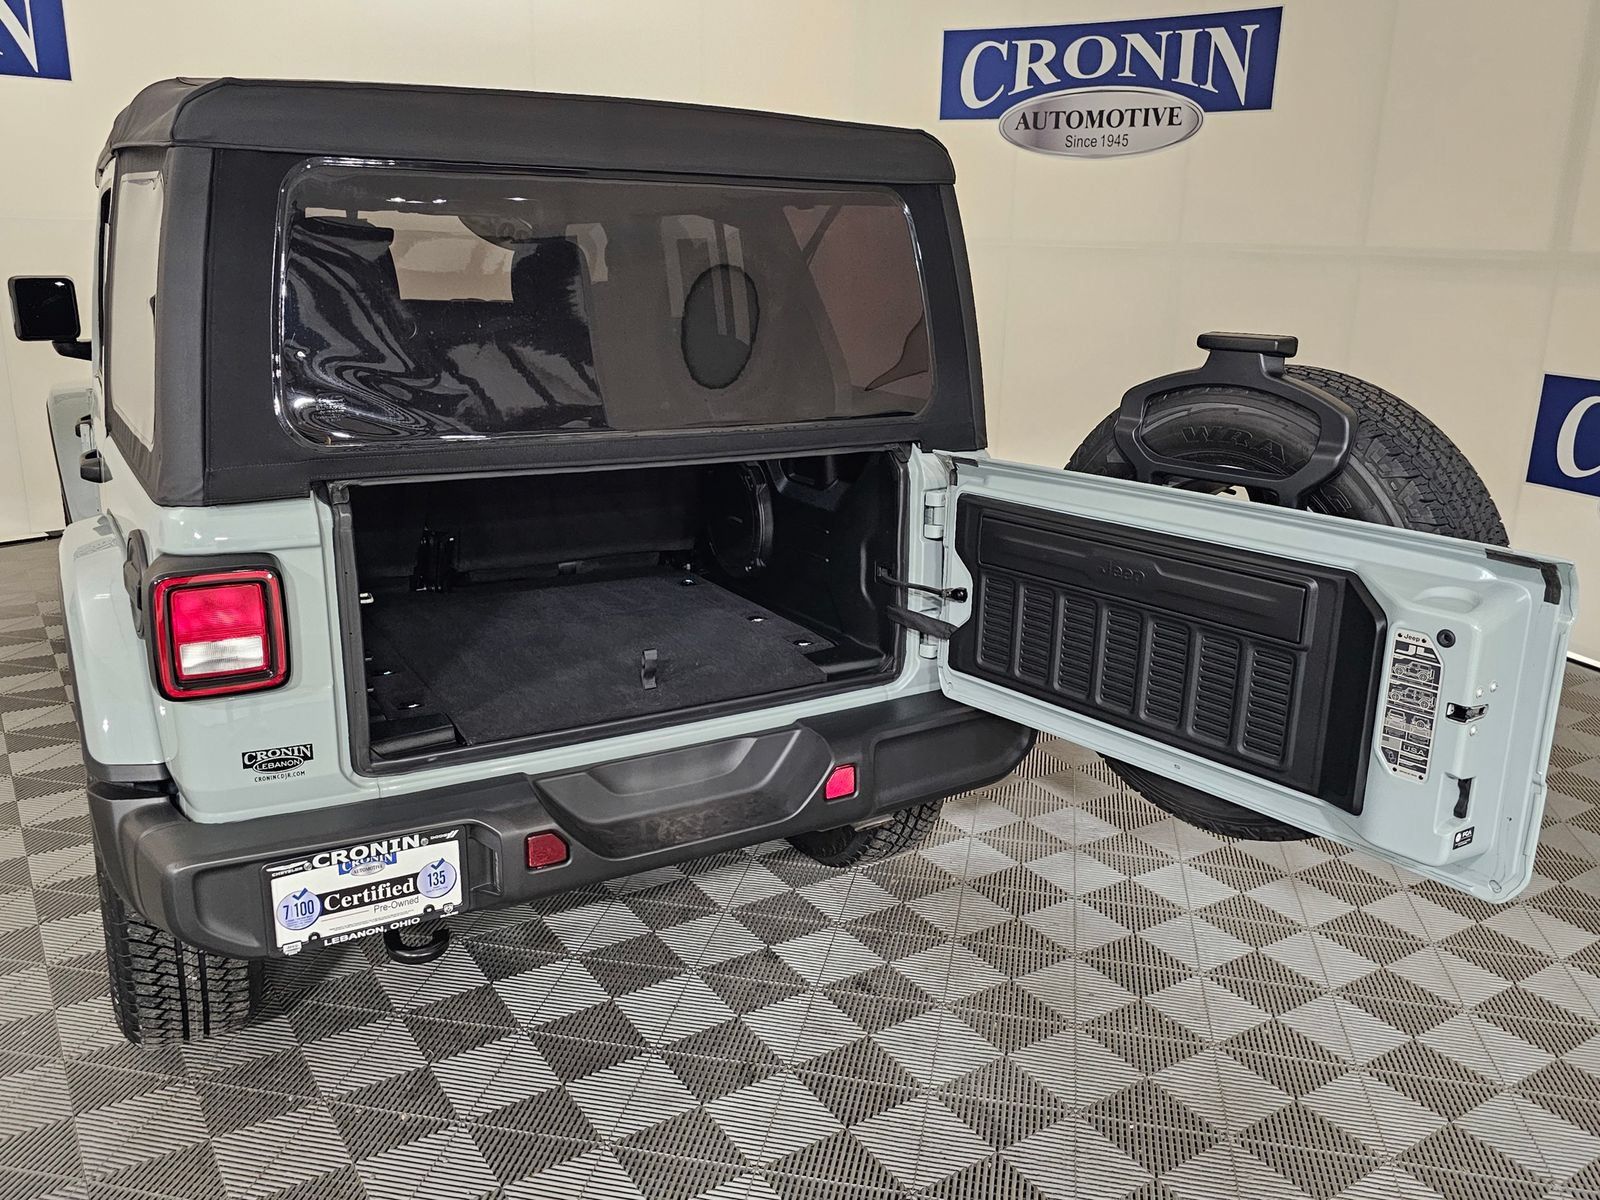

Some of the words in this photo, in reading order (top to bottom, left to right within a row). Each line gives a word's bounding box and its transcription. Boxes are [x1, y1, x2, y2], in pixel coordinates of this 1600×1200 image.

[960, 25, 1260, 109] CRONIN
[1015, 106, 1183, 131] AUTOMOTIVE
[1065, 134, 1098, 149] Since
[1101, 134, 1129, 148] 1945
[1404, 634, 1420, 642] Jeep
[244, 745, 311, 765] CRONIN
[257, 758, 300, 770] LEBANON
[255, 771, 305, 782] CRONINCDJR.COM
[312, 834, 420, 868] CRONIN
[428, 870, 446, 887] 135
[324, 878, 415, 911] Certified
[373, 896, 420, 913] Pre-Owned
[324, 925, 387, 946] LEBANON,
[390, 917, 421, 930] OHIO
